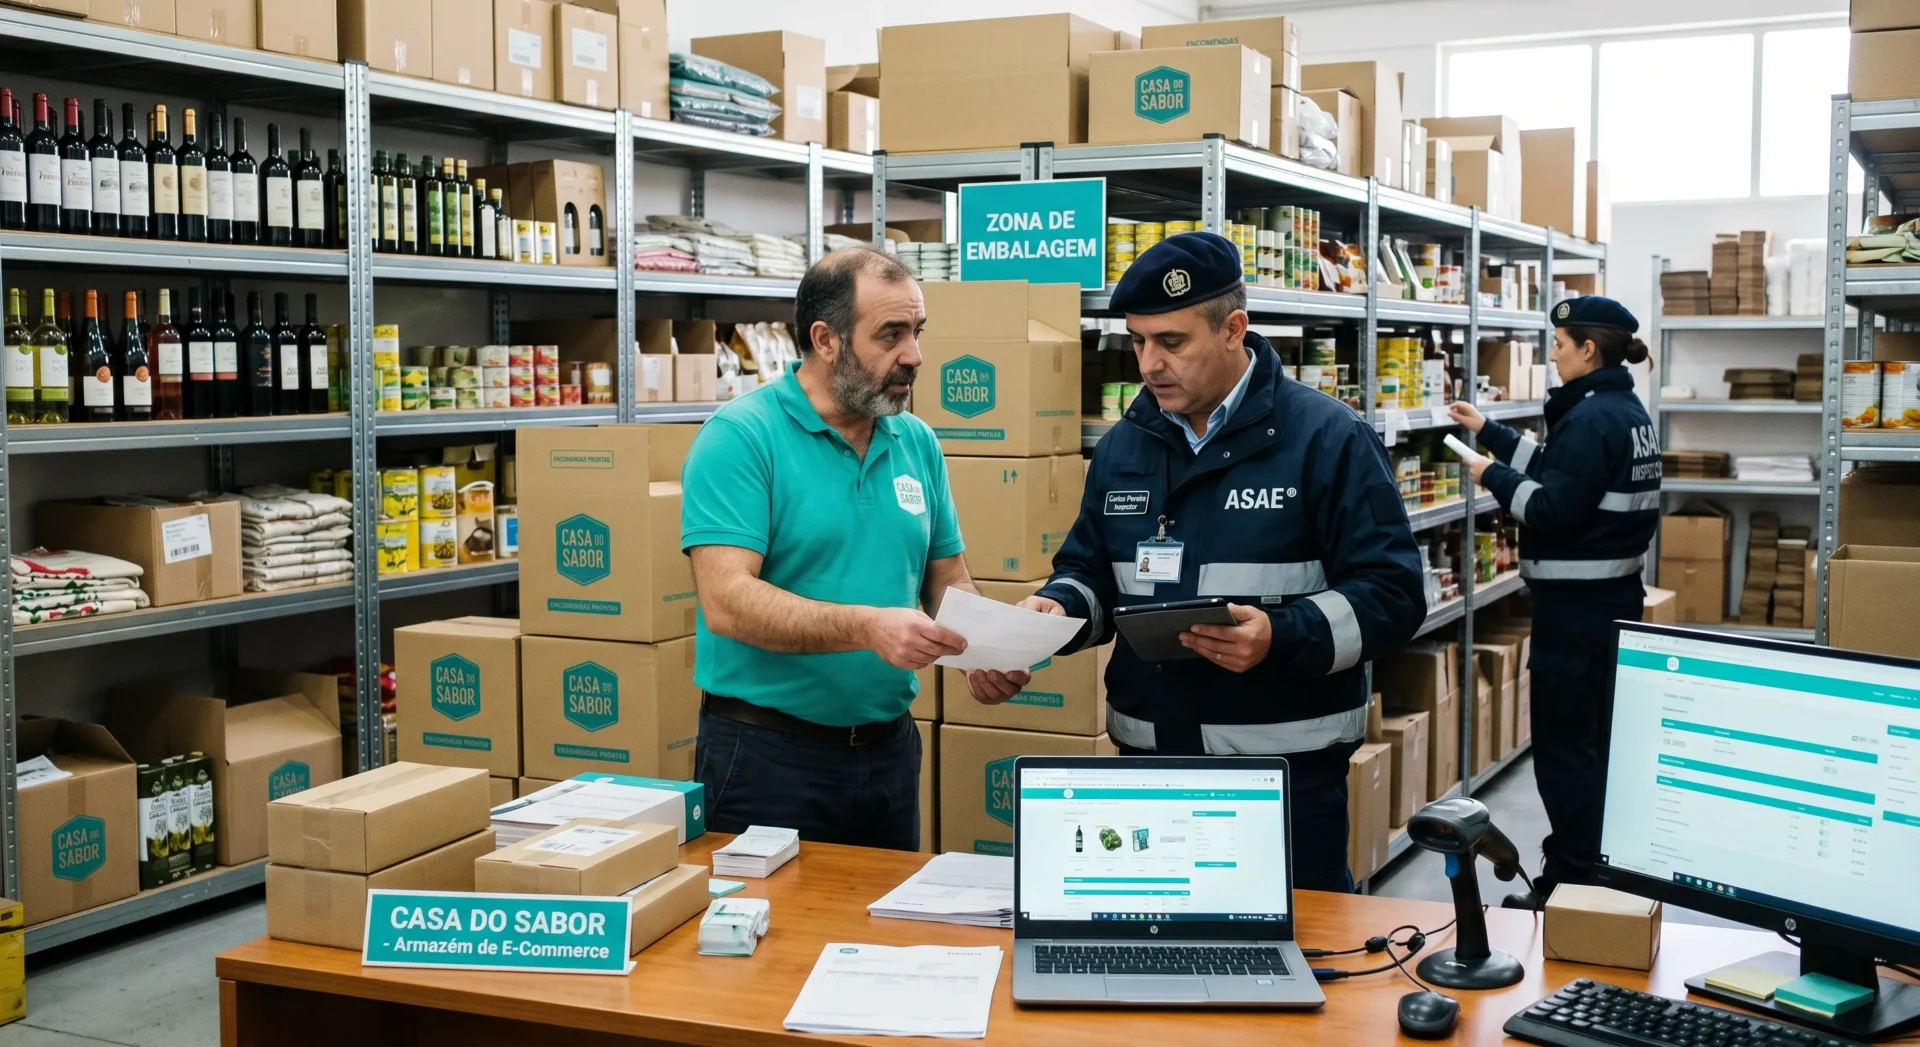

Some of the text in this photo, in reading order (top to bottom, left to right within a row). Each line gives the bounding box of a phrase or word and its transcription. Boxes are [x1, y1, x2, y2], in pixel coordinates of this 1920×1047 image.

[1140, 79, 1184, 94] CASA DO
[1140, 93, 1184, 111] SABOR
[986, 210, 1076, 232] ZONA DE
[966, 238, 1097, 260] EMBALAGEM
[946, 368, 979, 384] CASA
[947, 386, 989, 403] SABOR
[1631, 424, 1661, 459] ASA
[896, 482, 915, 493] CASA
[900, 493, 923, 505] SABOR
[561, 528, 593, 547] CASA
[562, 548, 605, 569] SABOR
[436, 666, 465, 685] CASA
[569, 674, 600, 695] CASA
[436, 684, 476, 706] SABOR
[569, 693, 613, 716] SABOR
[273, 771, 297, 790] CASA
[57, 827, 88, 850] CASA
[58, 842, 100, 869] SABOR
[390, 906, 606, 936] CASA DO SABOR
[394, 936, 473, 955] Armazém
[477, 939, 498, 955] de
[502, 940, 609, 959] E-Commerce
